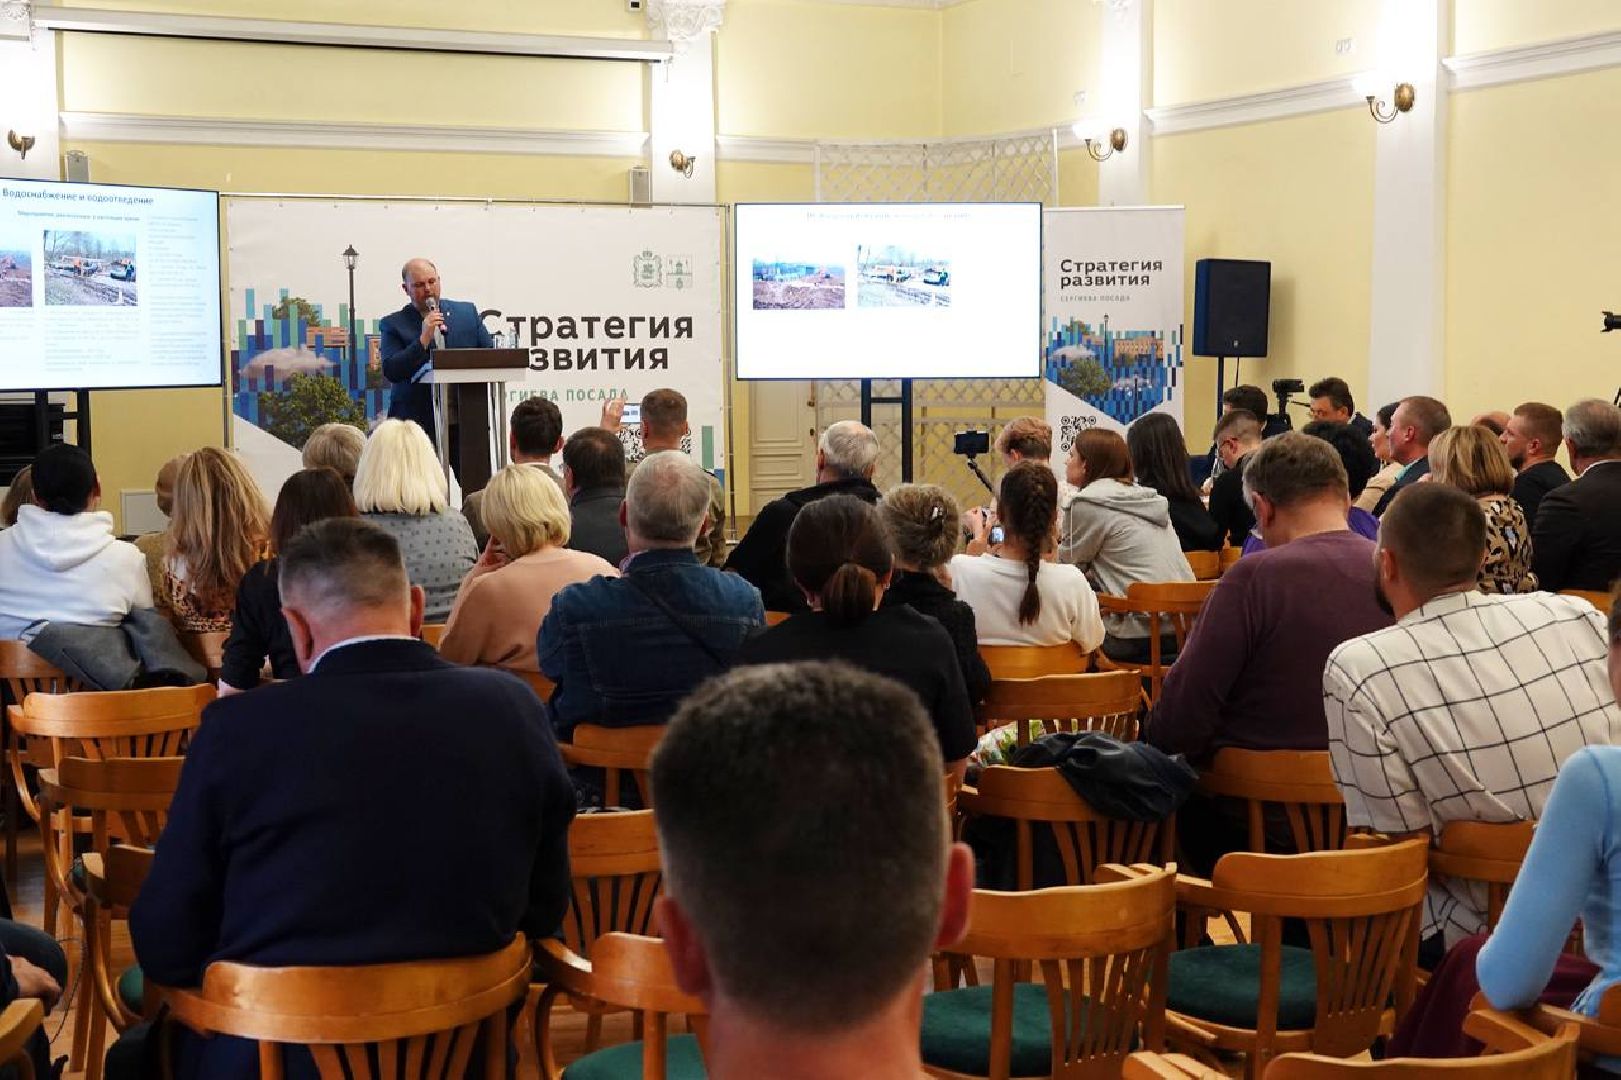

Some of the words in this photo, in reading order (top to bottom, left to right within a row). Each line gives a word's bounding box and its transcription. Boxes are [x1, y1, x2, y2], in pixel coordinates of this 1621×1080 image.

[1060, 259, 1163, 274] Стратегия
[1060, 275, 1150, 289] развития
[480, 309, 693, 347] Стратегия
[528, 347, 669, 371] звития
